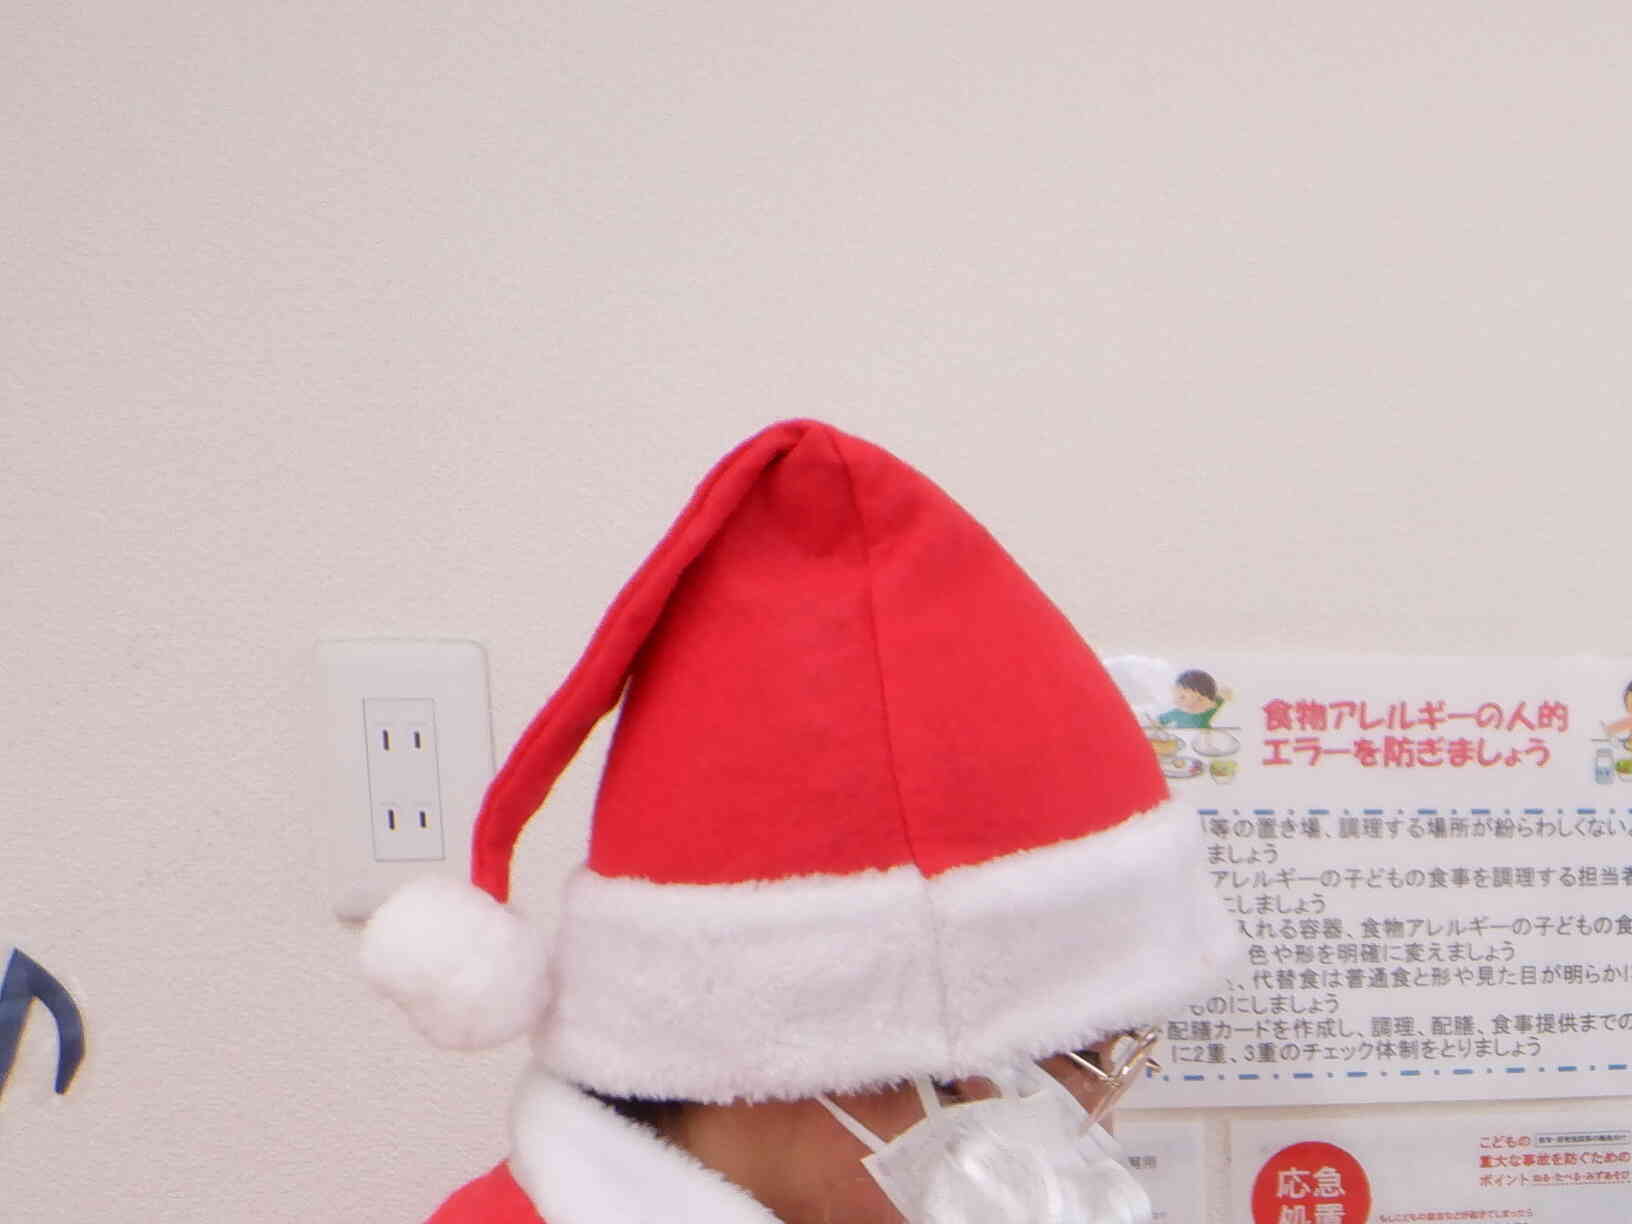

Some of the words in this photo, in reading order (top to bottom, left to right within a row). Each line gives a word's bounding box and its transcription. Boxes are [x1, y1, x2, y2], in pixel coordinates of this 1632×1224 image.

[1262, 699, 1569, 733] 食物アレルギーの人的
[1262, 736, 1551, 768] エラーを防ぎましょう
[1276, 1166, 1347, 1200] 応急
